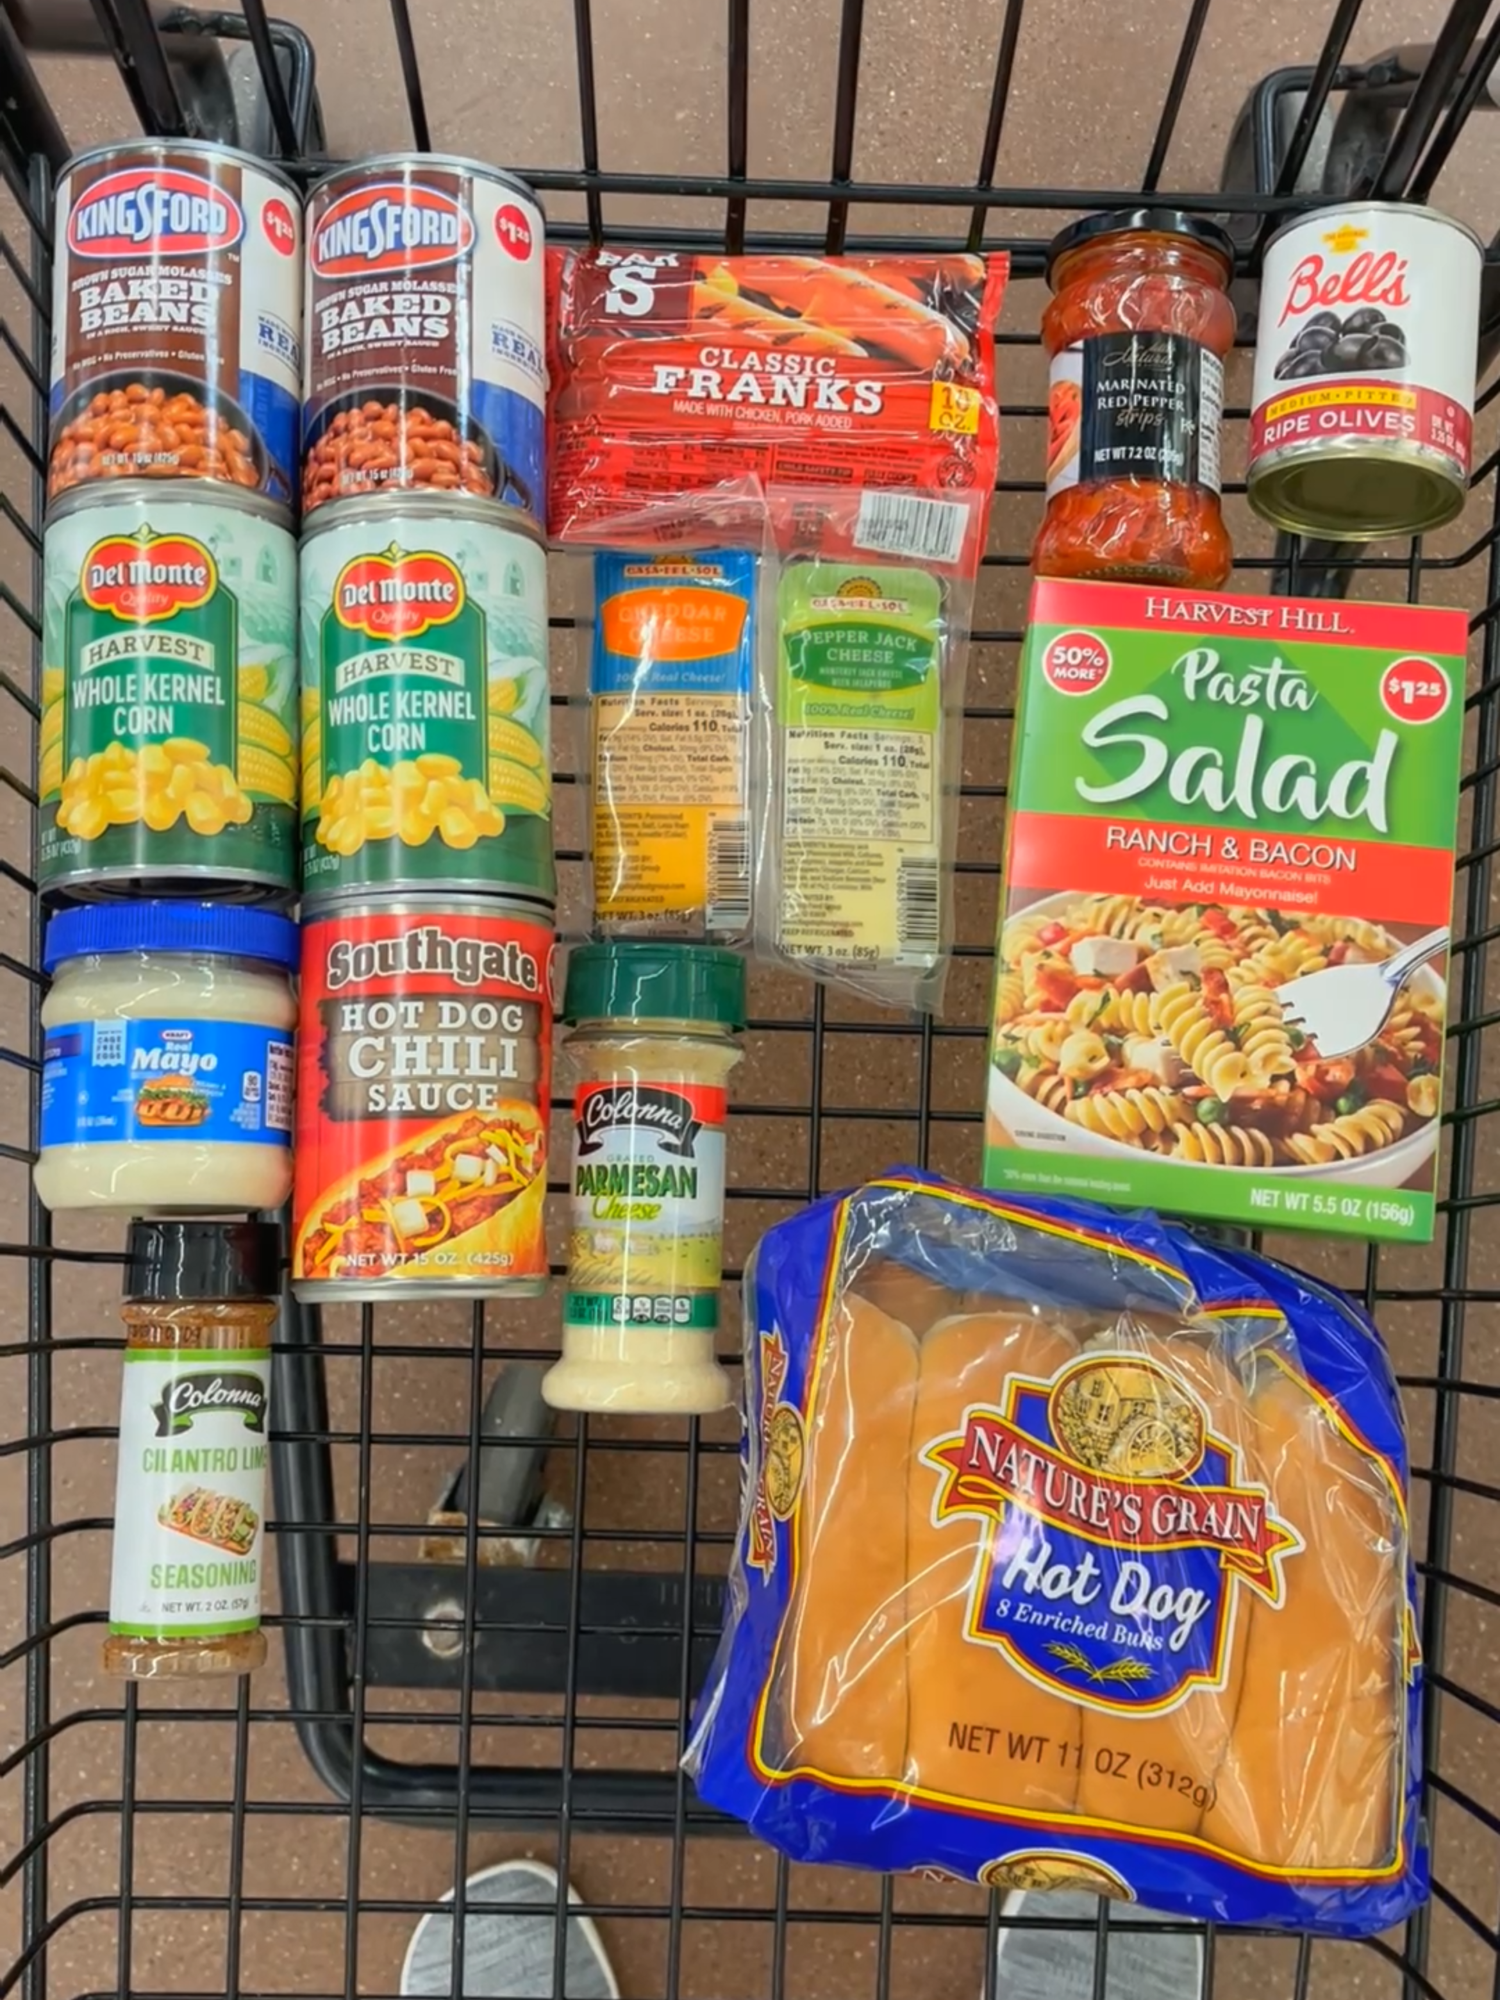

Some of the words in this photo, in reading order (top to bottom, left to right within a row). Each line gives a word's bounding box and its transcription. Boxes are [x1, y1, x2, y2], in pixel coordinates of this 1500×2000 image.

[76, 180, 229, 243] KINGSFORD
[318, 199, 458, 262] KINGSFORD
[110, 266, 153, 278] SUGAR
[79, 278, 219, 311] BAKED
[348, 282, 389, 298] SUGAR
[604, 264, 656, 317] S
[1277, 251, 1411, 328] Bell's
[80, 300, 217, 333] BEANS
[321, 293, 452, 332] BAKED
[322, 316, 450, 354] BEANS
[115, 350, 169, 361] Preservatives
[352, 365, 403, 379] Preservatives
[410, 362, 437, 374] Gluten
[699, 346, 837, 378] CLASSIC
[651, 363, 885, 417] FRANKS
[1095, 377, 1186, 395] MARINATED
[673, 400, 706, 416] MADE
[707, 403, 733, 418] WITH
[734, 404, 783, 423] CHICKEN,
[784, 410, 814, 427] PORK
[814, 412, 853, 430] ADDED
[1096, 396, 1129, 411] RED
[1133, 393, 1186, 412] PEPPER
[1268, 391, 1333, 418] MEDIUM
[1115, 408, 1166, 432] strips
[1263, 417, 1310, 445] RIPE
[1319, 410, 1416, 434] OLIVES
[1094, 448, 1111, 463] NET
[1112, 447, 1127, 461] WT
[1128, 446, 1143, 459] 7.2
[1144, 446, 1157, 460] OZ
[91, 563, 125, 589] Del
[129, 559, 207, 587] Monte
[343, 582, 378, 608] Del
[379, 578, 456, 604] Monte
[1144, 597, 1274, 627] HARVEST
[87, 634, 206, 666] HARVEST
[803, 630, 869, 646] PEPPER
[874, 633, 918, 652] JACK
[826, 648, 895, 664] CHEESE
[342, 652, 456, 685] HARVEST
[1051, 646, 1105, 668] 50%
[72, 674, 137, 709] WHOLE
[144, 673, 226, 706] KERNEL
[681, 672, 726, 684] Cheese!
[1170, 647, 1320, 712] Pasta
[327, 691, 389, 728] WHOLE
[395, 690, 477, 722] KERNEL
[634, 708, 660, 718] Serv.
[661, 708, 684, 718] size:
[650, 697, 680, 706] Facts
[804, 704, 840, 716] 100%
[113, 705, 174, 736] CORN
[648, 721, 690, 733] Calories
[840, 731, 869, 740] Facts
[367, 721, 427, 753] CORN
[823, 741, 849, 751] Serv.
[850, 742, 874, 752] size:
[686, 754, 709, 763] Total
[838, 755, 879, 767] Calories
[1075, 694, 1400, 834] Salad
[1106, 825, 1214, 860] RANCH
[1220, 834, 1242, 861] &
[1248, 839, 1357, 873] BACON
[1137, 857, 1198, 873] CONTAINS
[1200, 862, 1258, 878] IMITATION
[1259, 868, 1303, 882] BACON
[1304, 872, 1332, 886] BITS
[1144, 875, 1179, 892] Just
[1181, 877, 1215, 894] Add
[1219, 881, 1319, 905] Mayonnaise!
[326, 926, 538, 993] Southgate
[341, 1001, 425, 1032] HOT
[438, 1002, 524, 1033] DOG
[131, 1046, 219, 1077] Mayo
[348, 1036, 518, 1079] CHILI
[368, 1083, 500, 1112] SAUCE
[586, 1091, 684, 1131] Colonna
[606, 1154, 656, 1164] GRATED
[575, 1163, 699, 1200] PARMESAN
[591, 1194, 663, 1222] Cheese
[1249, 1188, 1283, 1209] NET
[1284, 1191, 1311, 1211] WT
[1313, 1194, 1338, 1214] 5.5
[1340, 1198, 1362, 1218] OZ
[1365, 1200, 1416, 1228] (156g)
[346, 1253, 377, 1268] NET
[380, 1253, 408, 1267] WT
[413, 1252, 429, 1266] 15
[433, 1252, 458, 1266] OZ
[466, 1252, 515, 1268] (425g)
[168, 1376, 262, 1413] Colonna
[142, 1447, 238, 1474] CILANTRO
[967, 1425, 1144, 1537] NATURE'S
[1151, 1496, 1264, 1544] GRAIN
[150, 1559, 257, 1590] SEASONING
[161, 1602, 182, 1614] NET
[184, 1602, 202, 1613] WT.
[206, 1602, 213, 1612] 2
[213, 1601, 230, 1612] OZ.
[1002, 1538, 1103, 1601] Hot
[1109, 1560, 1212, 1653] Dog
[995, 1599, 1009, 1618] 8
[1012, 1603, 1109, 1642] Enriched
[1112, 1625, 1165, 1652] Buns
[948, 1722, 1001, 1755] NET
[1006, 1733, 1051, 1764] WT
[1057, 1744, 1086, 1771] 11
[1094, 1748, 1133, 1780] OZ
[1136, 1760, 1219, 1812] (312g)
